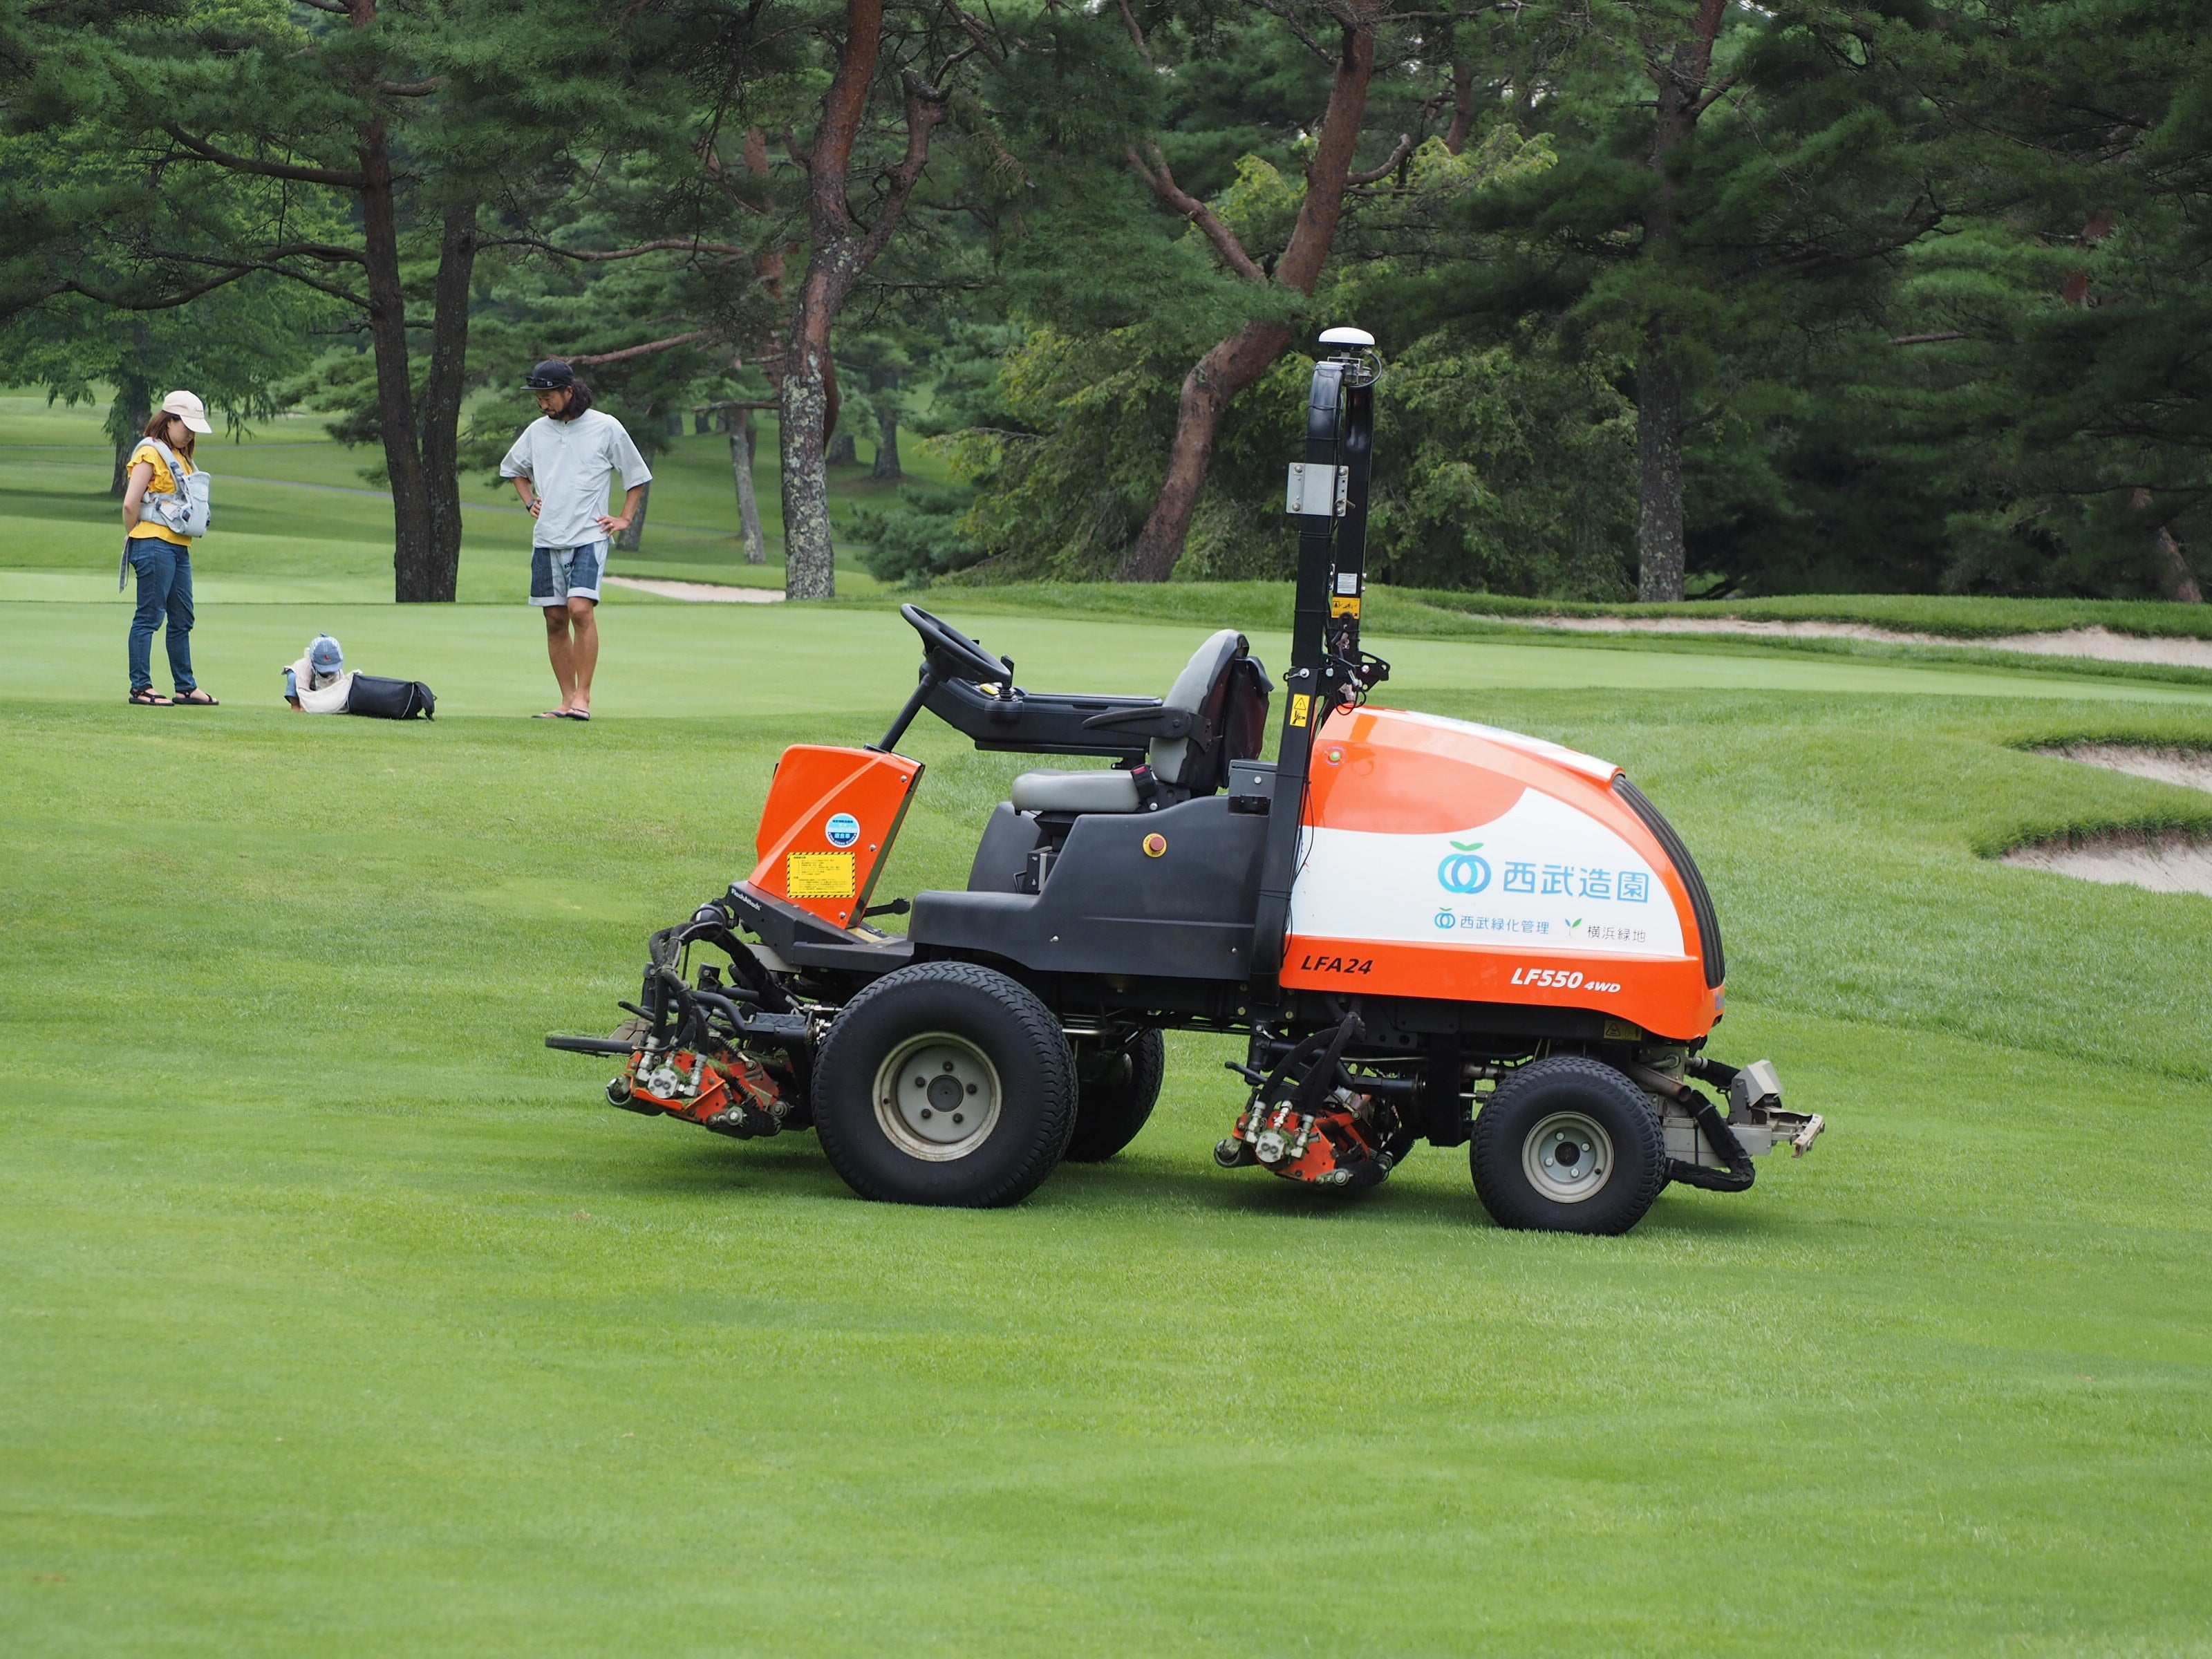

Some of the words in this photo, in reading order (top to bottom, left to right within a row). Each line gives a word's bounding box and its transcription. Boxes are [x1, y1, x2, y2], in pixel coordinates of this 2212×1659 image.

[1503, 861, 1649, 903] 西武造園
[1460, 915, 1550, 935] 西武緑化管理
[1587, 926, 1646, 943] 横浜緑地
[1300, 955, 1373, 974] LFA24
[1510, 967, 1584, 988] LF550
[1584, 981, 1621, 993] 4WD
